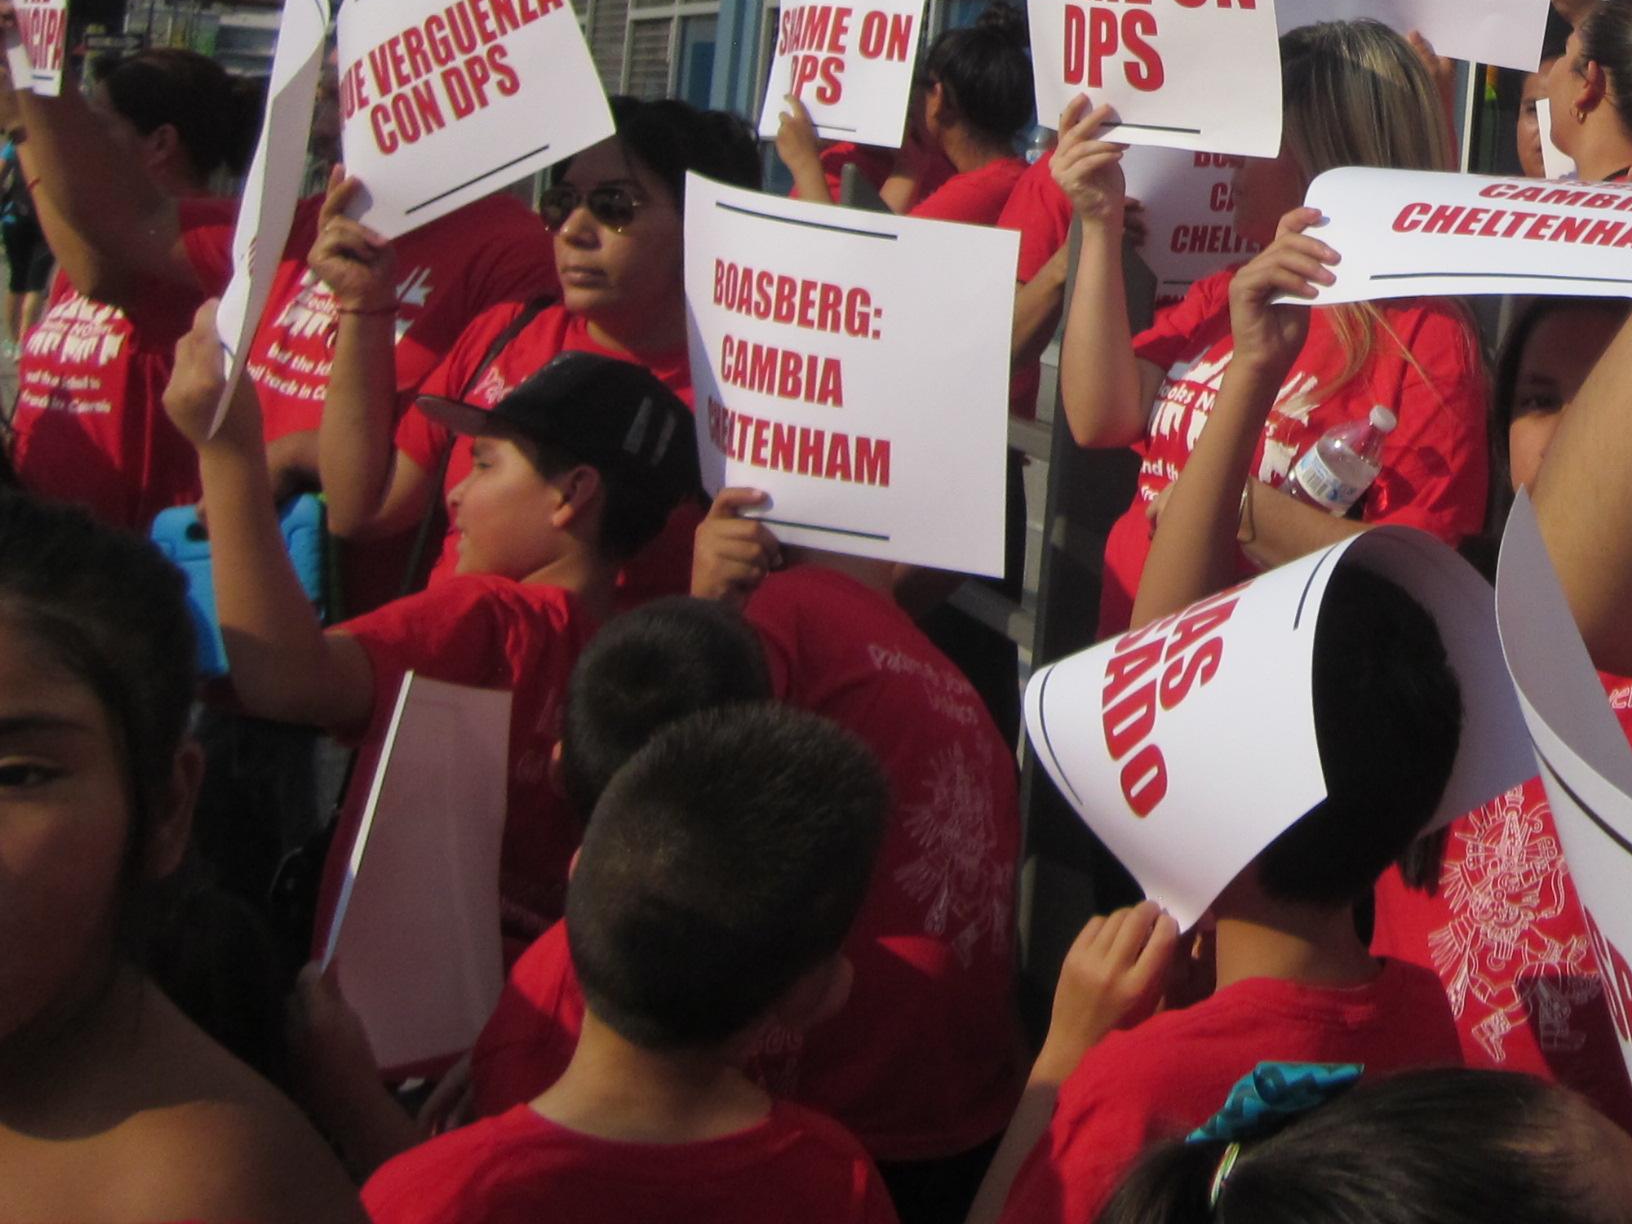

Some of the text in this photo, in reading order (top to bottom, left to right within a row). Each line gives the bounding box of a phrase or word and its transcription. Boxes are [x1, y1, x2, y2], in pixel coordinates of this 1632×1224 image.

[779, 4, 914, 63] SHAME ON
[1063, 4, 1165, 92] DPS
[370, 43, 521, 155] CON DPS
[713, 257, 883, 340] BOASBERG:
[720, 334, 844, 408] CAMBIA
[707, 394, 892, 488] CHELTENHAM
